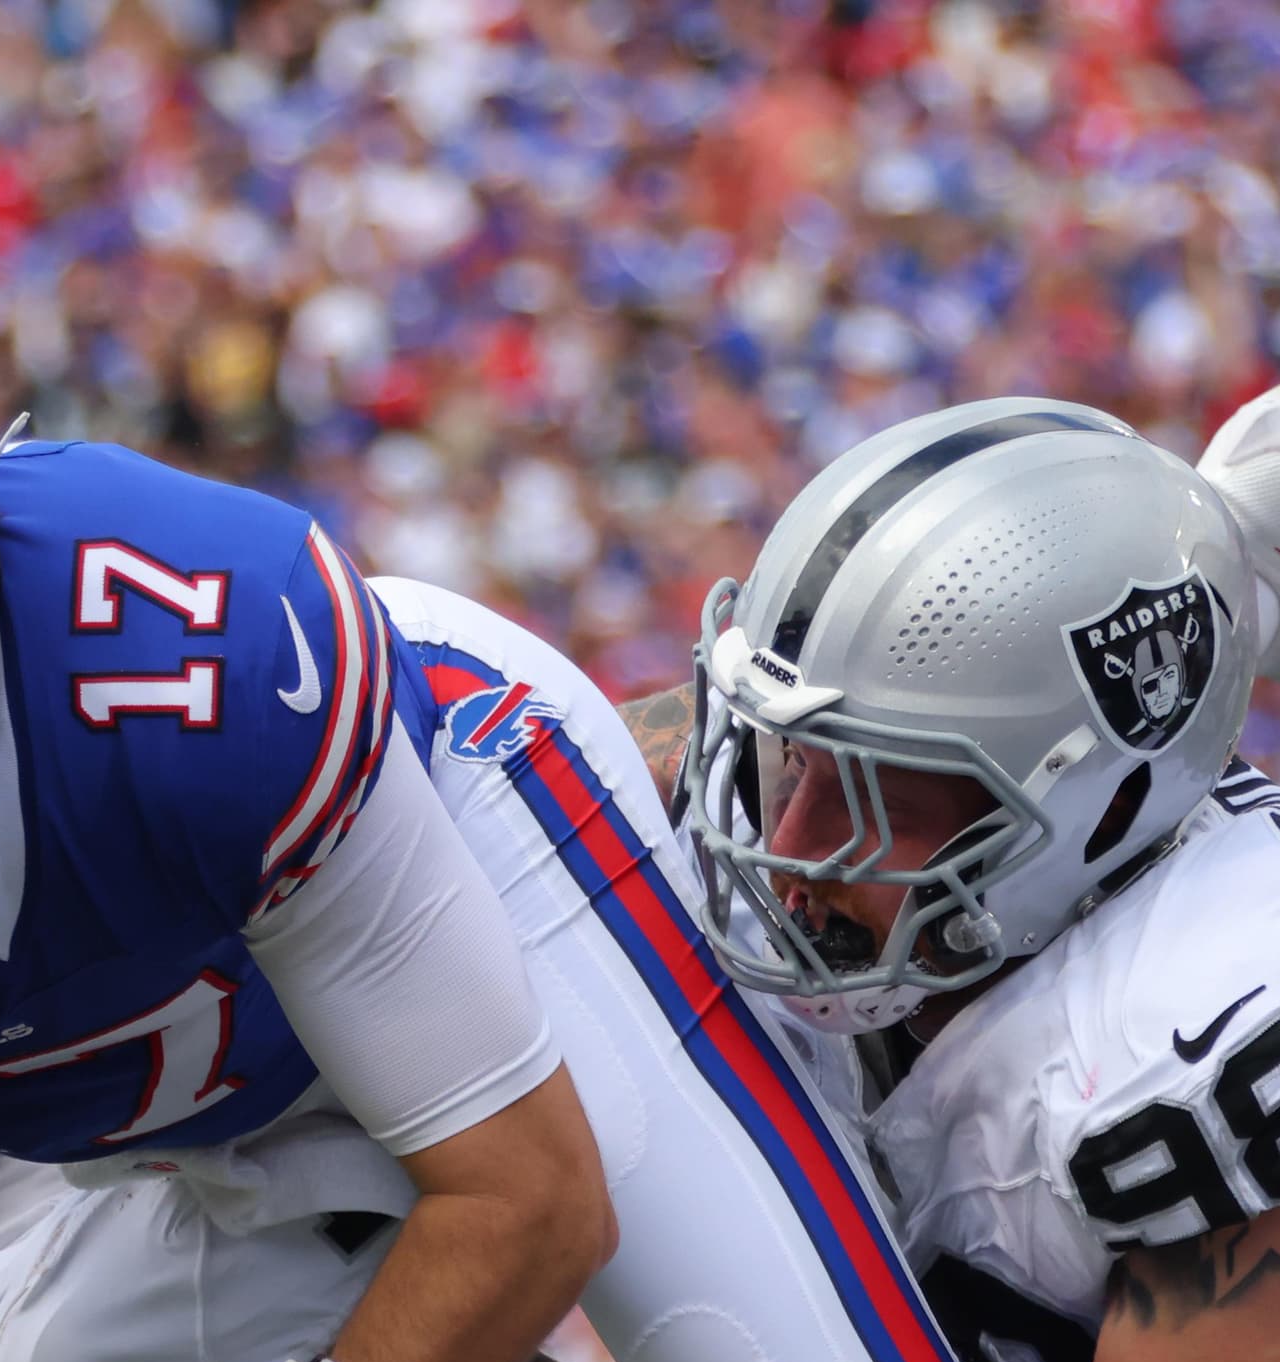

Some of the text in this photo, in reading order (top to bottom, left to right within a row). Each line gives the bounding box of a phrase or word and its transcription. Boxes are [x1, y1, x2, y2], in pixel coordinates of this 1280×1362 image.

[70, 536, 234, 736] 17
[1087, 583, 1197, 649] RAIDERS
[750, 651, 799, 689] RAIDERS
